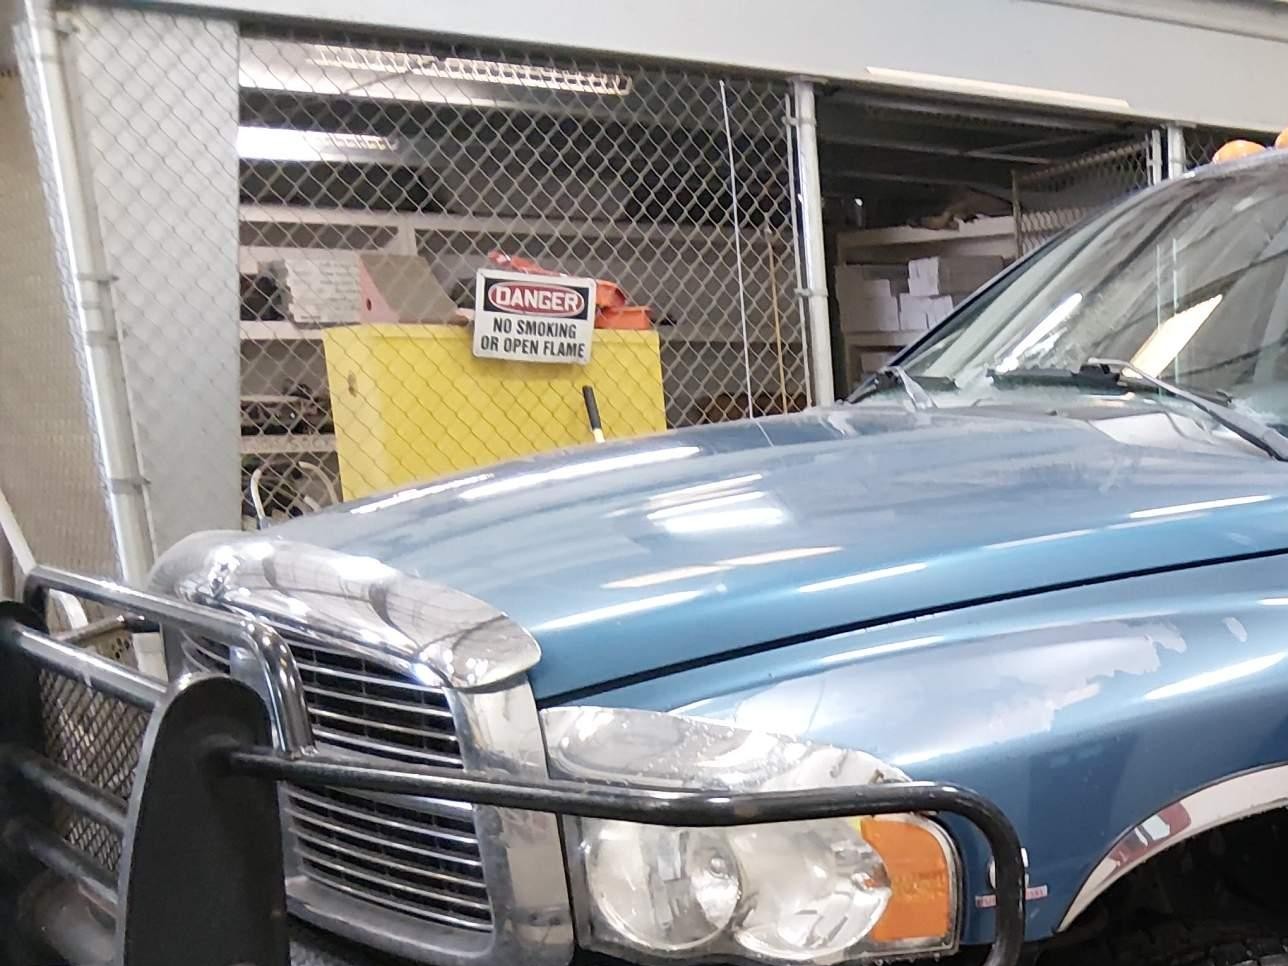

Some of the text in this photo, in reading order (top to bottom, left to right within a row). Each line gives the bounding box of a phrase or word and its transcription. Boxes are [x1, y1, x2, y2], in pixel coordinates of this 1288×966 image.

[494, 287, 579, 311] DANGER
[493, 317, 577, 339] NO SMOKING
[480, 335, 585, 358] OR OPEN FLAME
